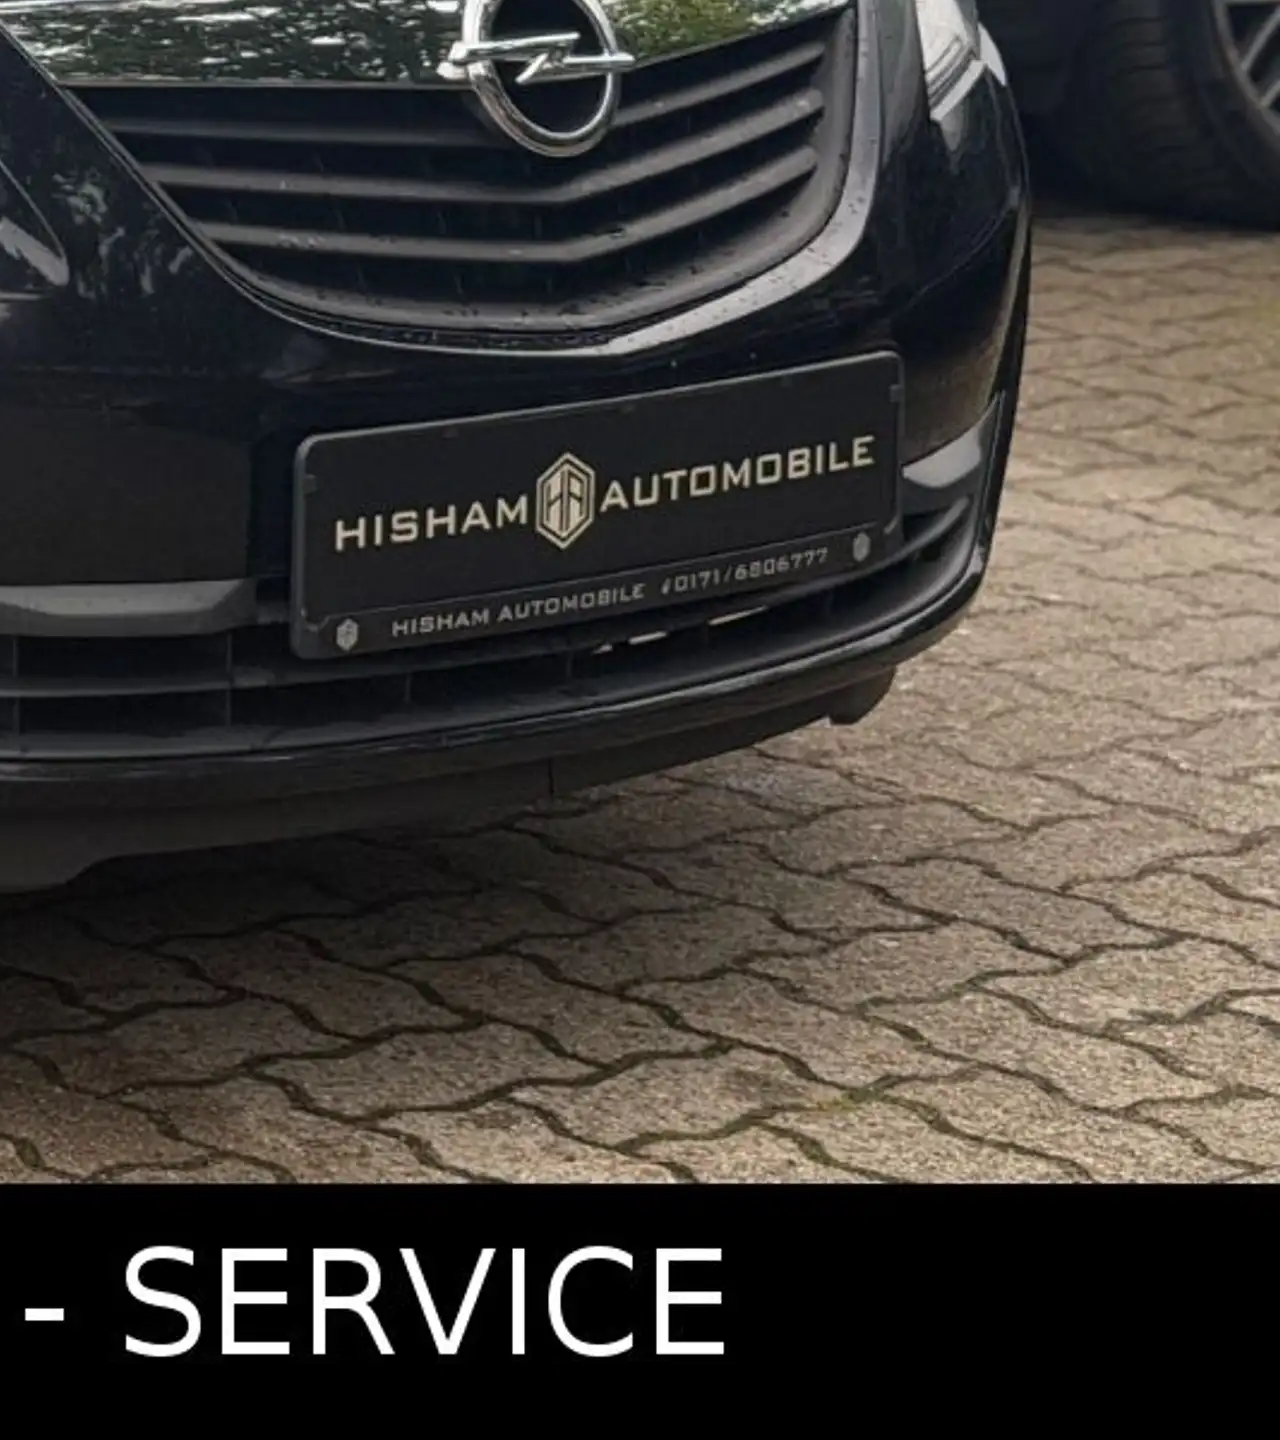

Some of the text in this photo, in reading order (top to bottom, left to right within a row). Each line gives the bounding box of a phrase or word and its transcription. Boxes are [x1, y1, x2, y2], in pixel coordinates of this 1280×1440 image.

[334, 493, 528, 552] HISHAM
[600, 435, 876, 513] AUTOMOBILE
[392, 608, 490, 638] HISHAM
[497, 582, 646, 622] AUTOMOBILE
